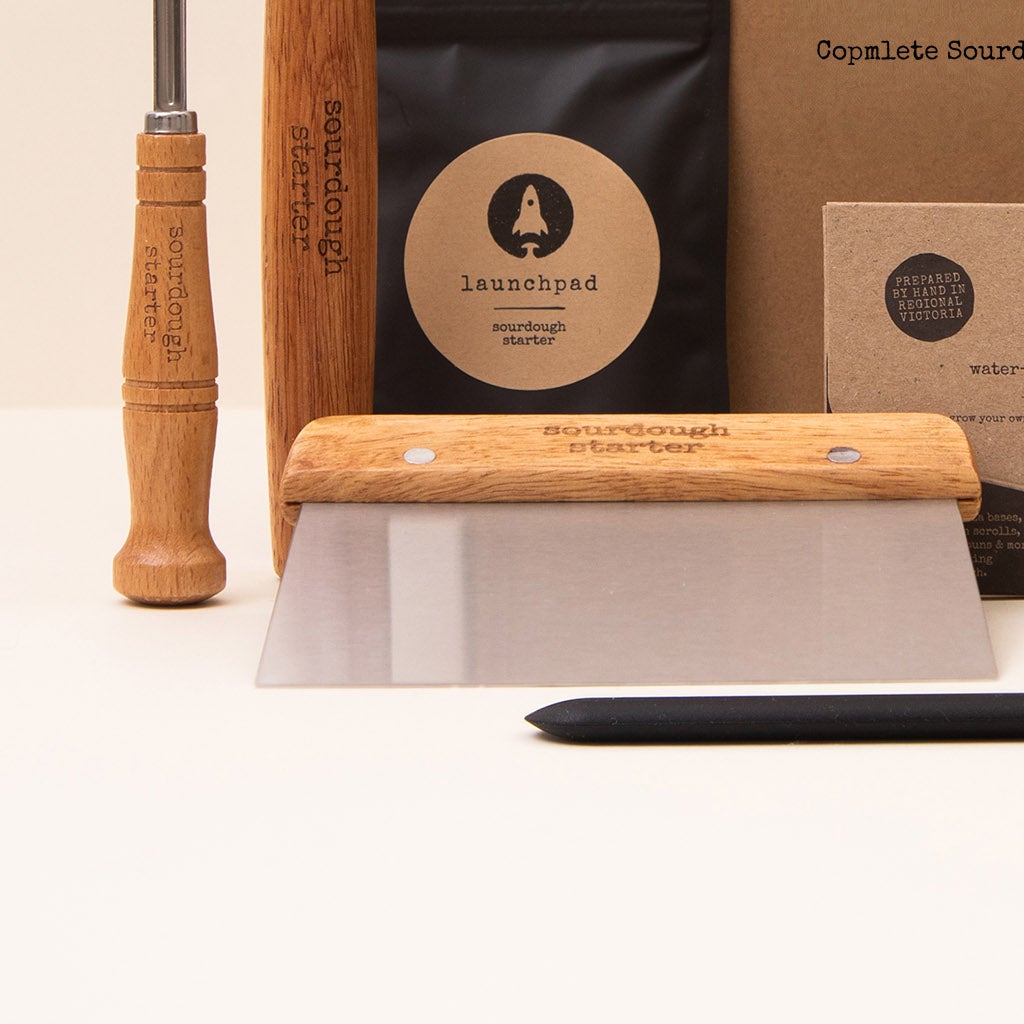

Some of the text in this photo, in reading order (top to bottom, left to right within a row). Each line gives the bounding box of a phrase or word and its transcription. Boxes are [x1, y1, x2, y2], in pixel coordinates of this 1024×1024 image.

[817, 39, 939, 65] Copmlete
[291, 125, 315, 251] starter
[318, 100, 349, 276] sourdough
[461, 274, 598, 295] launchpad
[896, 272, 961, 286] PREPARED
[144, 246, 161, 343] starter
[162, 226, 188, 363] sourdough
[893, 284, 966, 298] BY HAND IN
[898, 296, 963, 310] REGIONAL
[900, 308, 963, 322] VICTORIA
[492, 321, 567, 334] sourdough
[502, 335, 556, 345] starter
[978, 414, 1005, 425] your
[543, 422, 731, 440] sourdough
[569, 440, 705, 454] starter
[987, 512, 1022, 524] bases,
[973, 526, 1021, 537] scrolls,
[995, 539, 1004, 549] &
